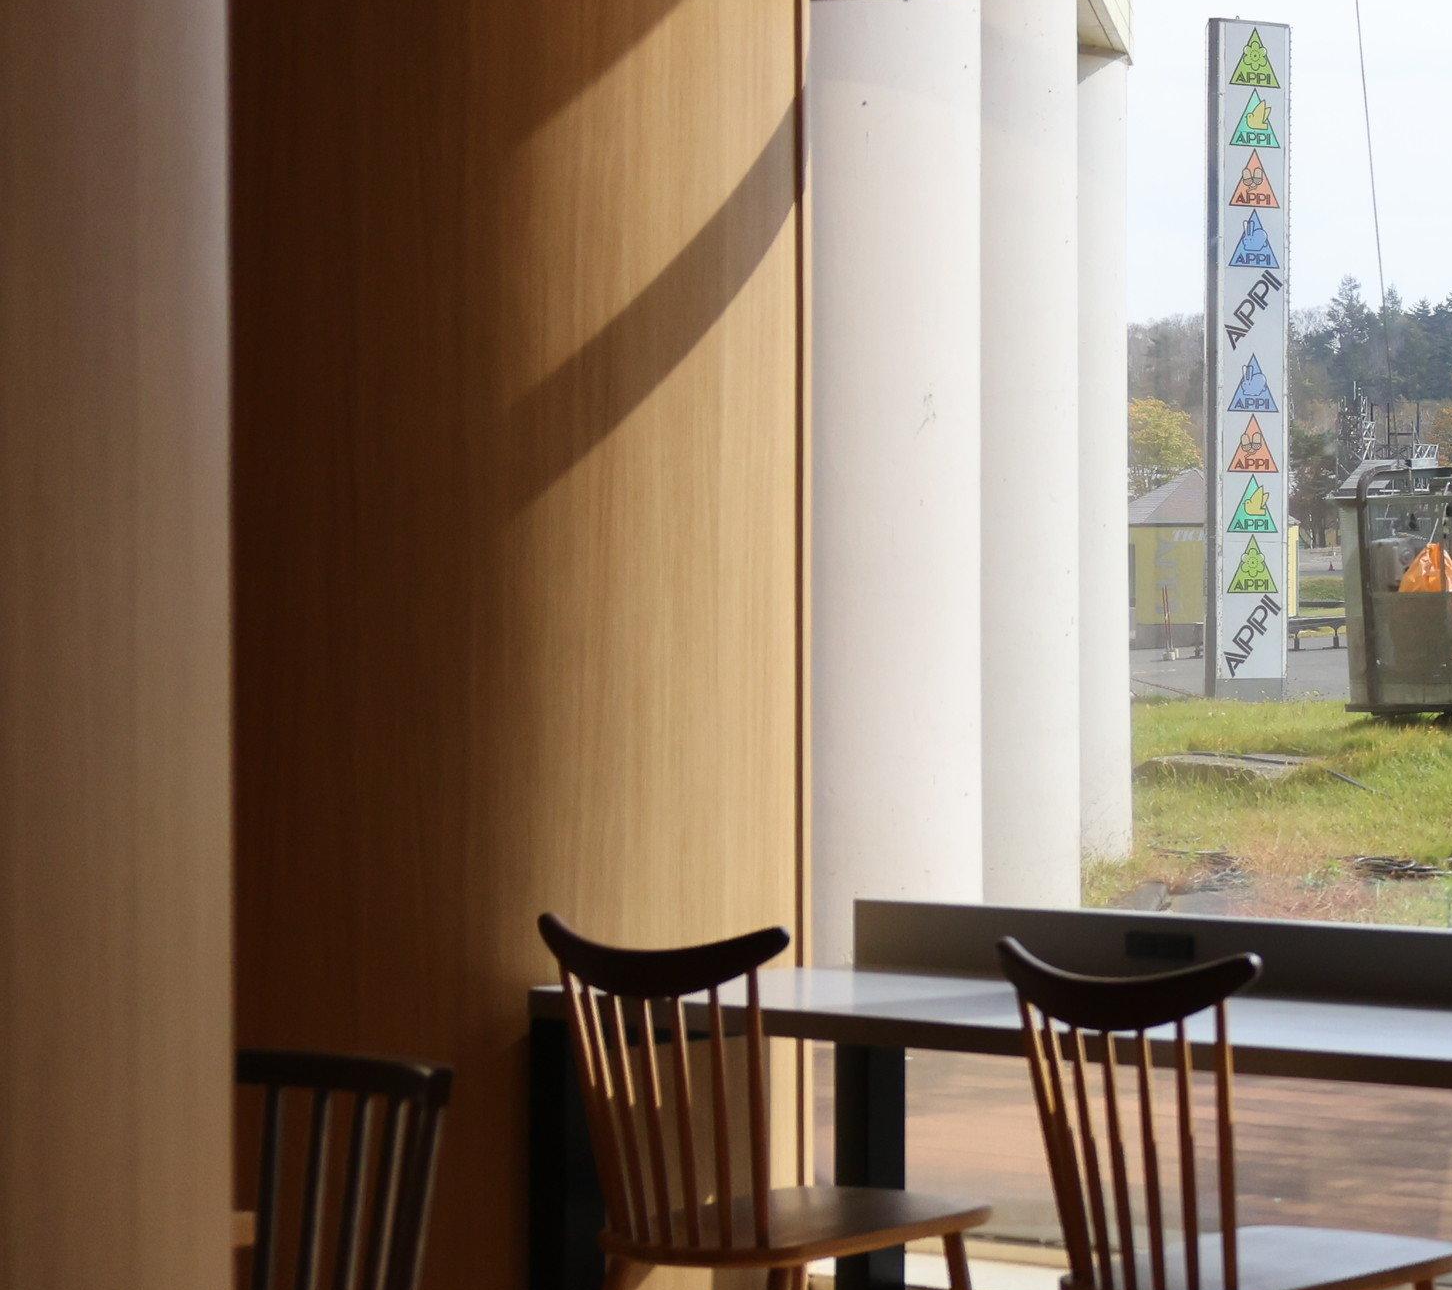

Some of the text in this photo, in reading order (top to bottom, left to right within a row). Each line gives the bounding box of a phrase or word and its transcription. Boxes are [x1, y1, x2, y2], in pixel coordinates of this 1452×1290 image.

[1235, 71, 1271, 85] APPI
[1235, 132, 1271, 145] APPI
[1235, 192, 1271, 205] APPI
[1235, 253, 1271, 266] APPI
[1223, 269, 1283, 351] APPI
[1234, 397, 1270, 410] APPI
[1234, 458, 1270, 470] APPI
[1233, 519, 1269, 530] APPI
[1233, 579, 1269, 591] APPI
[1223, 593, 1282, 678] APPI
